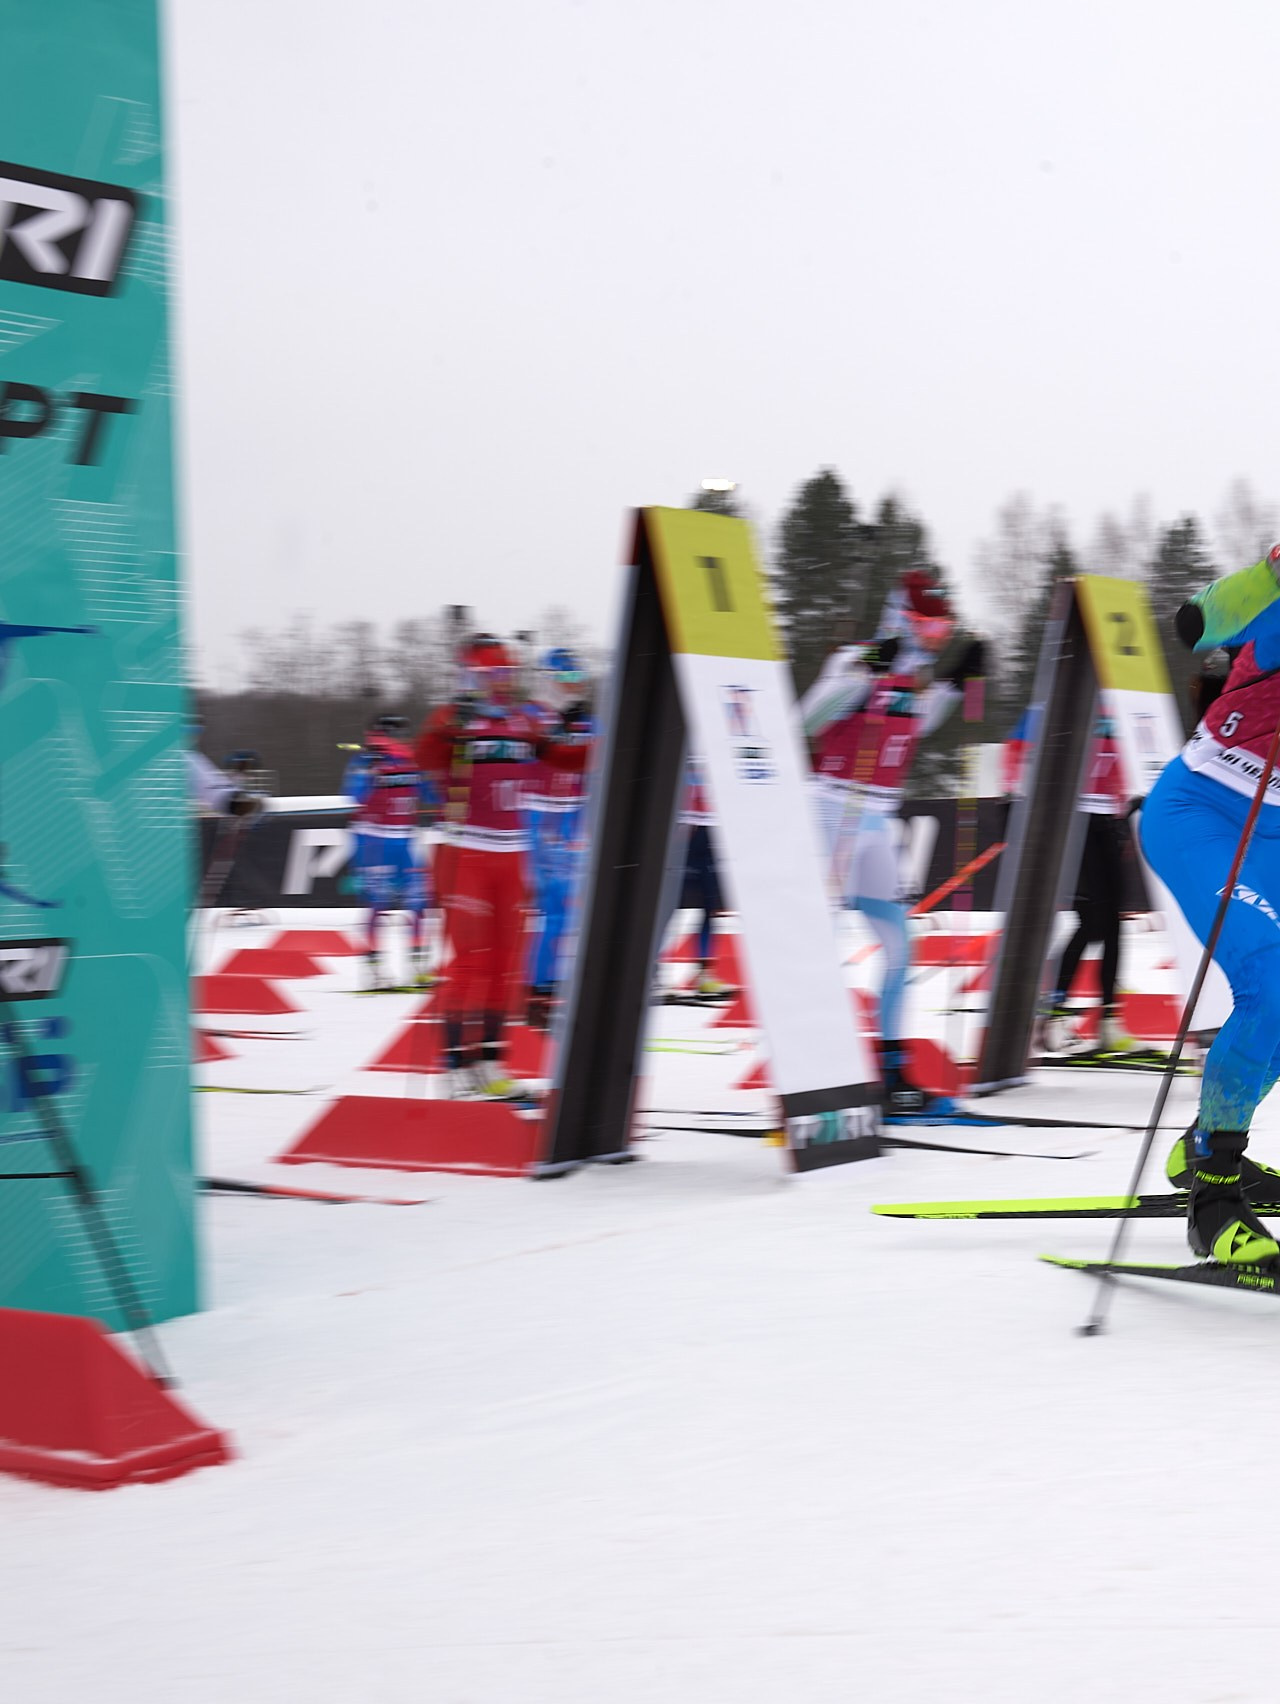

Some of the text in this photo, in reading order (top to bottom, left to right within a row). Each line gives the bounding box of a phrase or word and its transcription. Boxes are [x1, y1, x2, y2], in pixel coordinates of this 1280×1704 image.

[696, 555, 735, 612] 1
[1105, 612, 1146, 656] 2
[1219, 711, 1245, 738] 5
